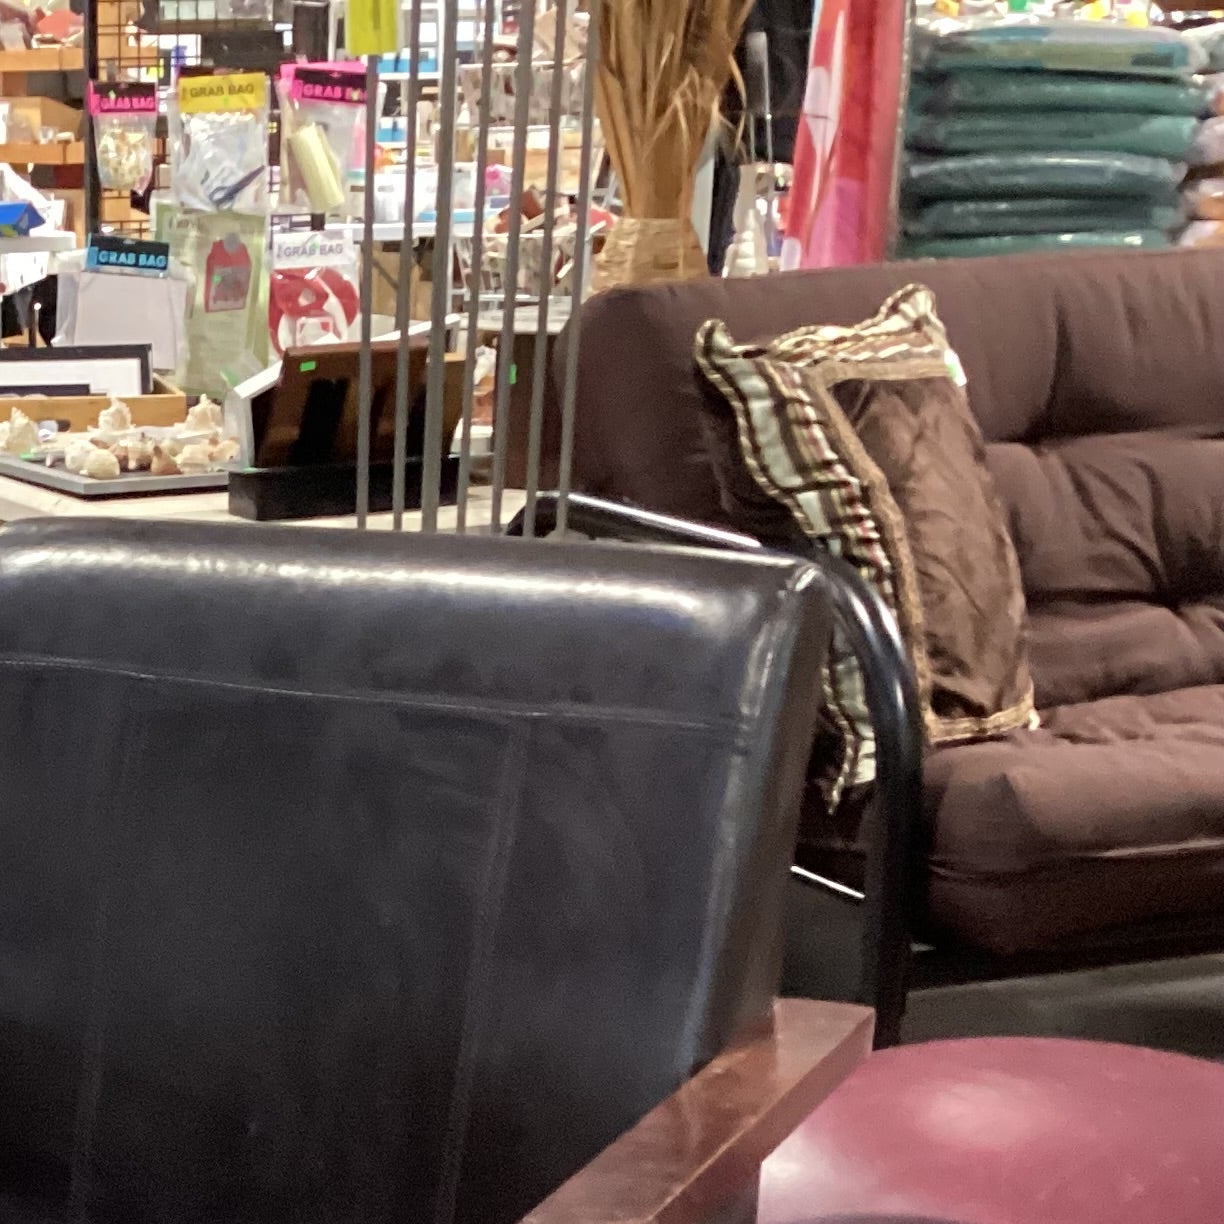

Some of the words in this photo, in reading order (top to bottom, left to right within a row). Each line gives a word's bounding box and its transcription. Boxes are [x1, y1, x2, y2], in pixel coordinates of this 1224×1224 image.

[190, 86, 225, 98] GRAB
[228, 83, 255, 95] BAG
[303, 83, 342, 99] GRAB
[132, 96, 154, 110] BAG
[283, 245, 317, 257] GRAB
[319, 243, 344, 255] BAG
[98, 250, 136, 265] GRAB
[139, 253, 167, 268] BAG
